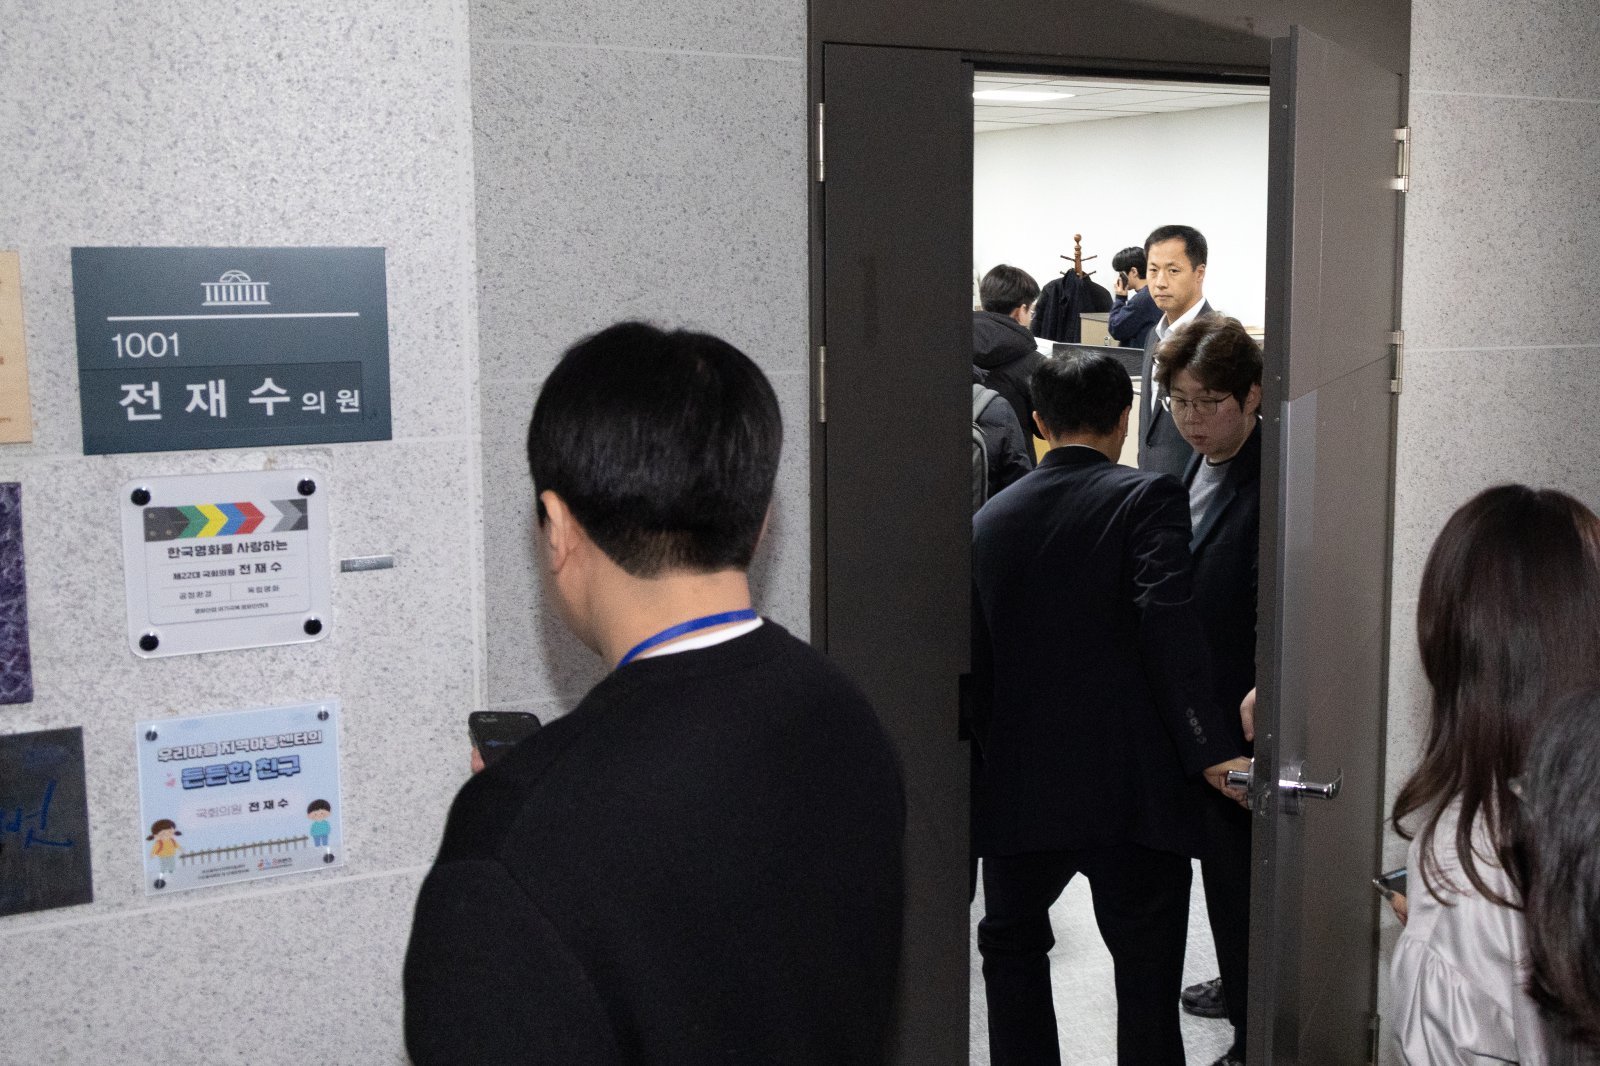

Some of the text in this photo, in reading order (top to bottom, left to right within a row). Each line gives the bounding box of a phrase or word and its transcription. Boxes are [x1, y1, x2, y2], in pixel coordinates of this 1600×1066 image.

[111, 332, 179, 358] 1001
[237, 540, 288, 553] 사랑하는
[173, 571, 201, 580] 제22대
[202, 569, 235, 578] 국회의원
[157, 730, 323, 762] 우리마을 지역아동센터의
[181, 754, 301, 790] 든든한 친구
[195, 804, 243, 819] 국회의원
